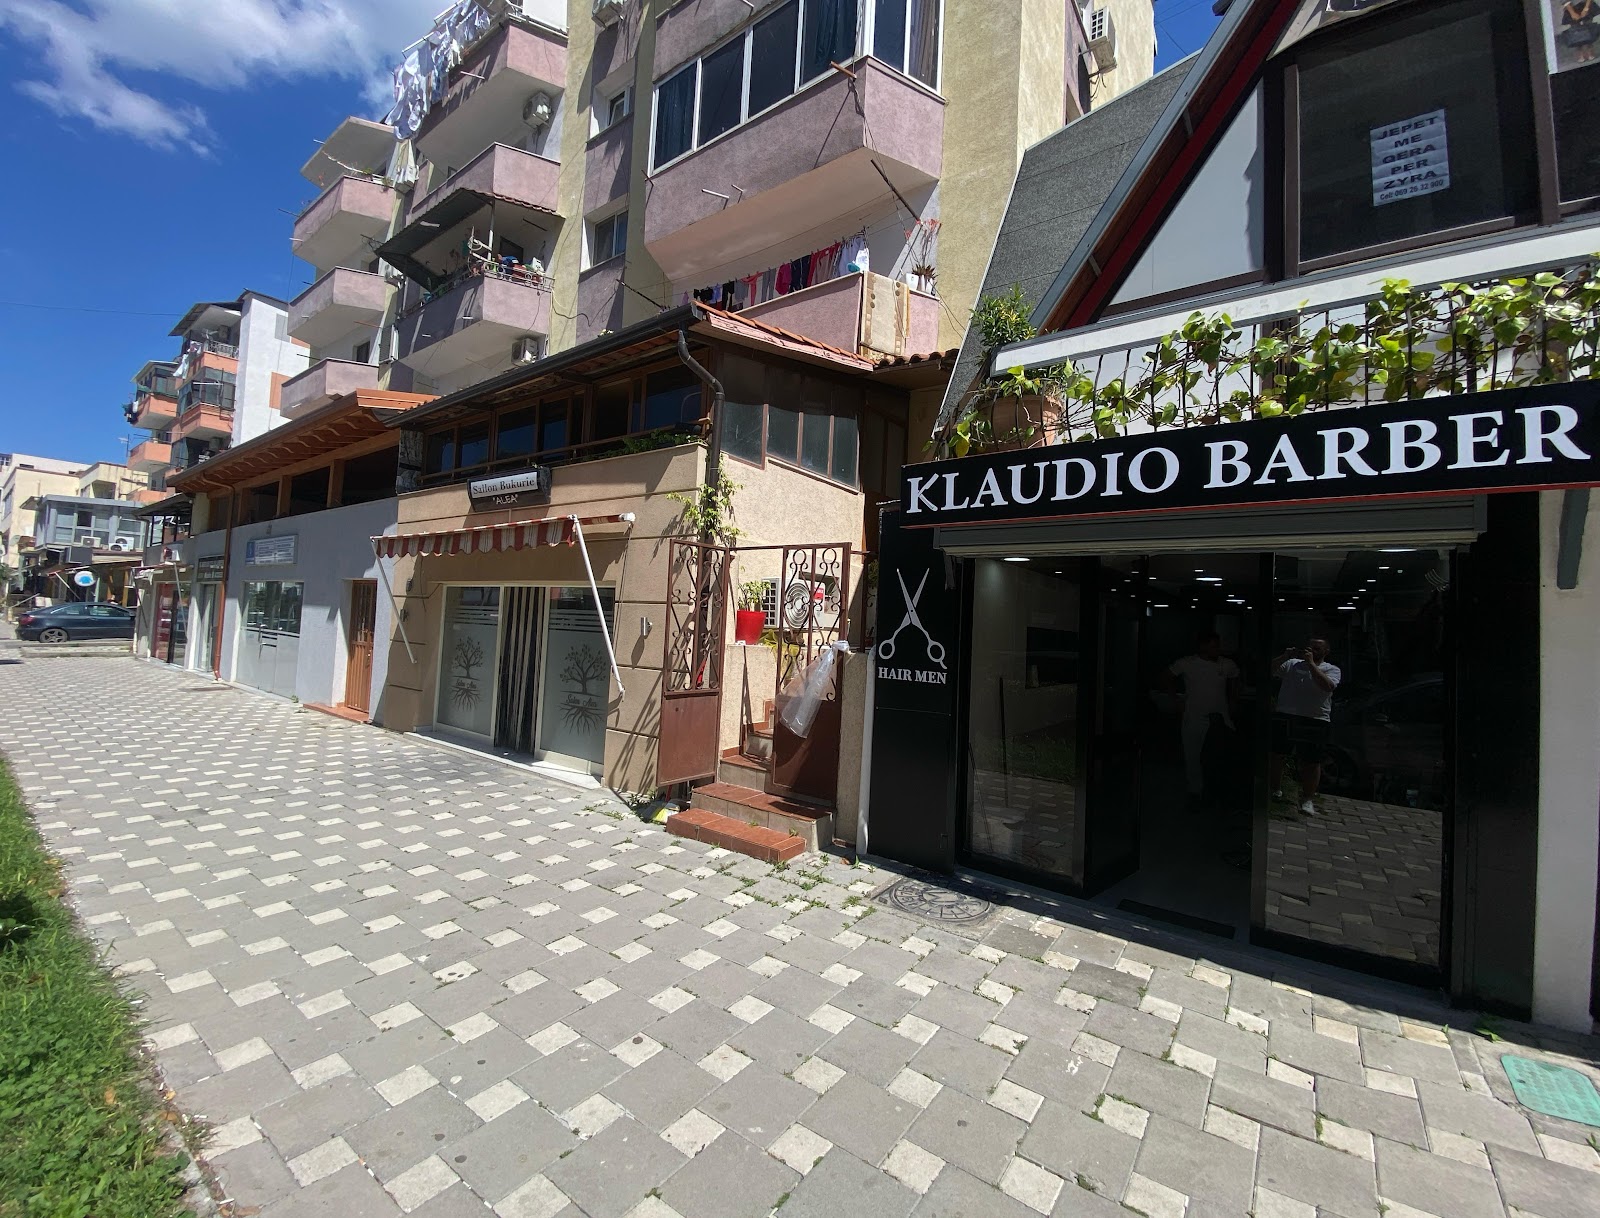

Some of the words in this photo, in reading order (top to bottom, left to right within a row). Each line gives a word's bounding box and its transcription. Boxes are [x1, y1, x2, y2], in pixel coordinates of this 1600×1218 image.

[1378, 116, 1438, 139] JEPET
[1394, 134, 1422, 148] ME
[1382, 144, 1436, 164] QERA
[1391, 159, 1429, 175] PER
[1383, 171, 1437, 190] ZYRA
[906, 446, 1180, 514] KLAUDIO
[1203, 404, 1592, 490] BARBER
[500, 477, 535, 491] Bukurie
[878, 667, 912, 682] HAIR
[915, 670, 947, 685] MEN
